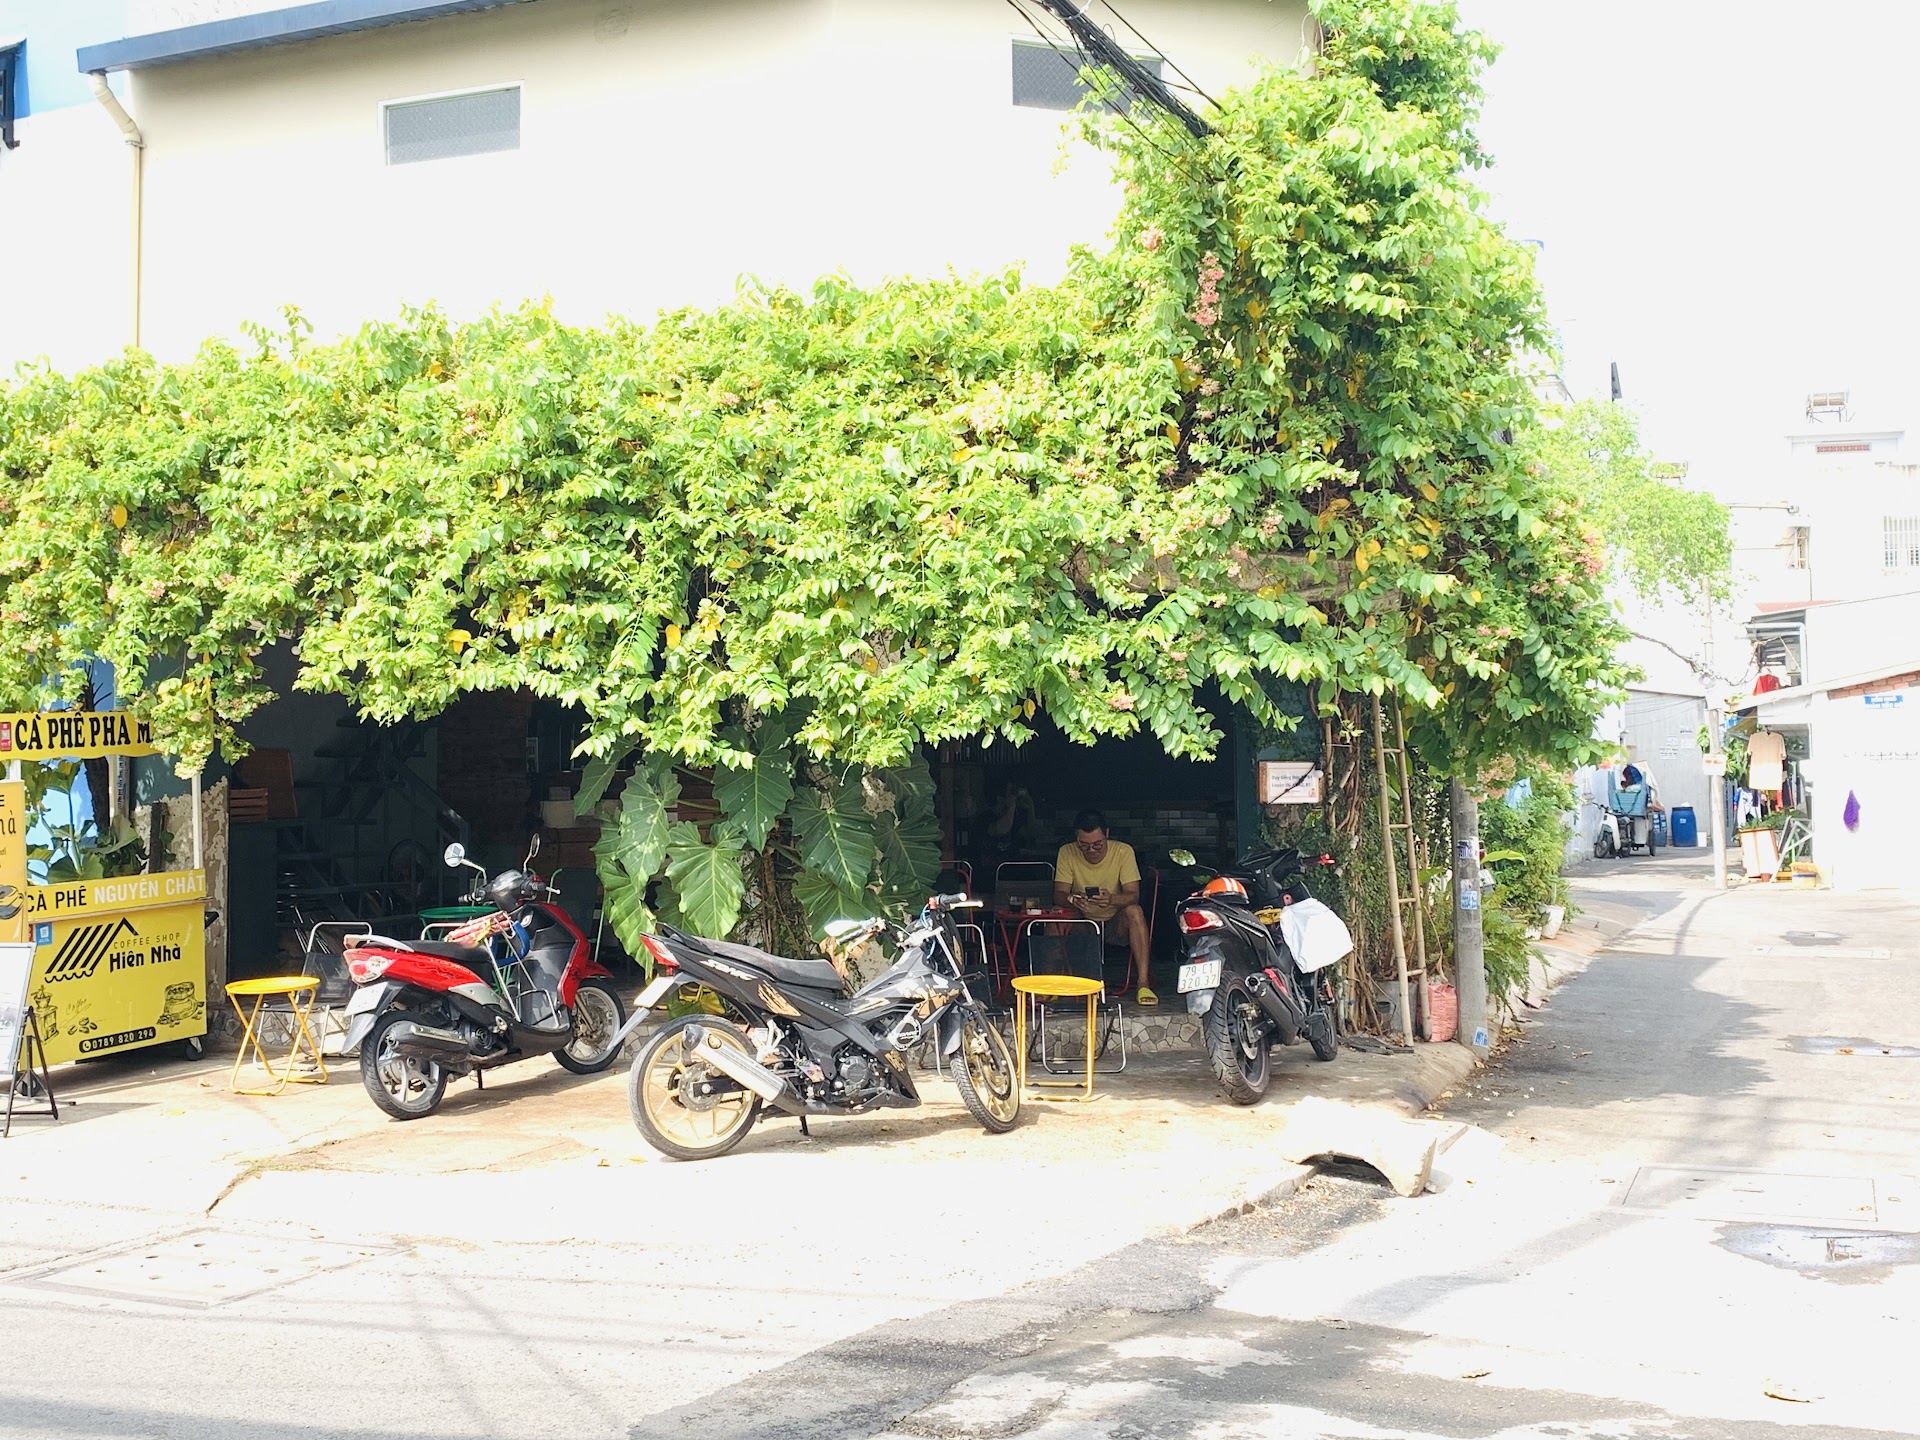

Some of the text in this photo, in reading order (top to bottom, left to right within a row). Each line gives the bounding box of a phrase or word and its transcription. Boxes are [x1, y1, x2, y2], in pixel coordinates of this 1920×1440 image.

[15, 714, 43, 750] CÀ
[47, 712, 85, 749] PHÊ
[89, 715, 131, 747] PHA
[27, 890, 47, 912] CÀ
[55, 885, 87, 909] PHÊ
[94, 878, 158, 904] NGUYÊN
[113, 933, 180, 949] COFFEE SHOP
[109, 943, 181, 973] Hiên Nhà
[92, 1029, 154, 1049] 0789 820 294
